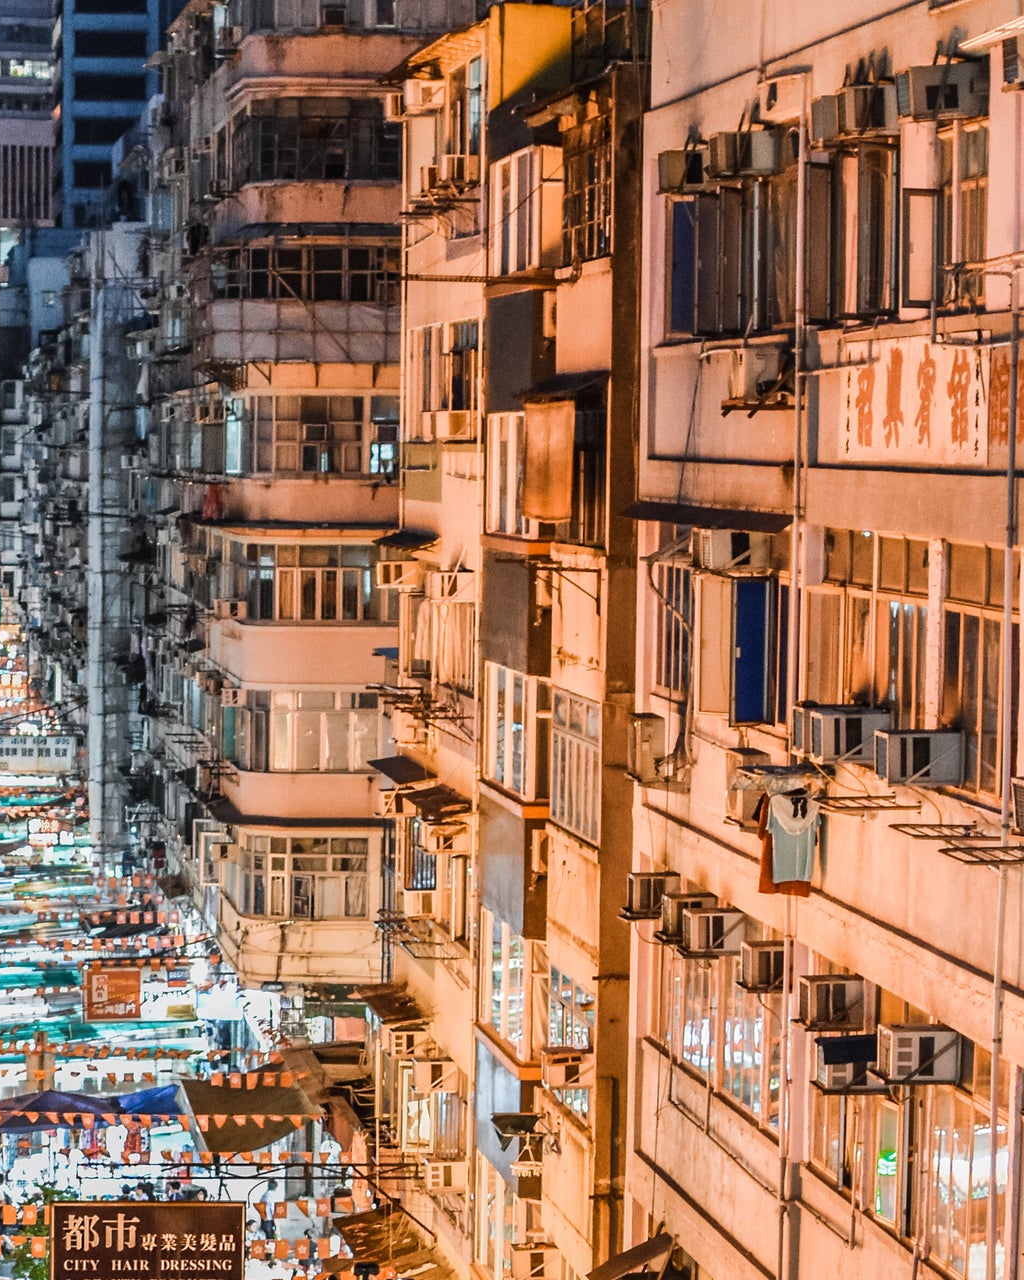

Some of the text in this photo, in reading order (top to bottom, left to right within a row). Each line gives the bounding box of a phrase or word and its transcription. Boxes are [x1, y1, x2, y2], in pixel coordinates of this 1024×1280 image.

[62, 1213, 140, 1252] 都市
[63, 1259, 232, 1271] CITY HAIR DRESSING
